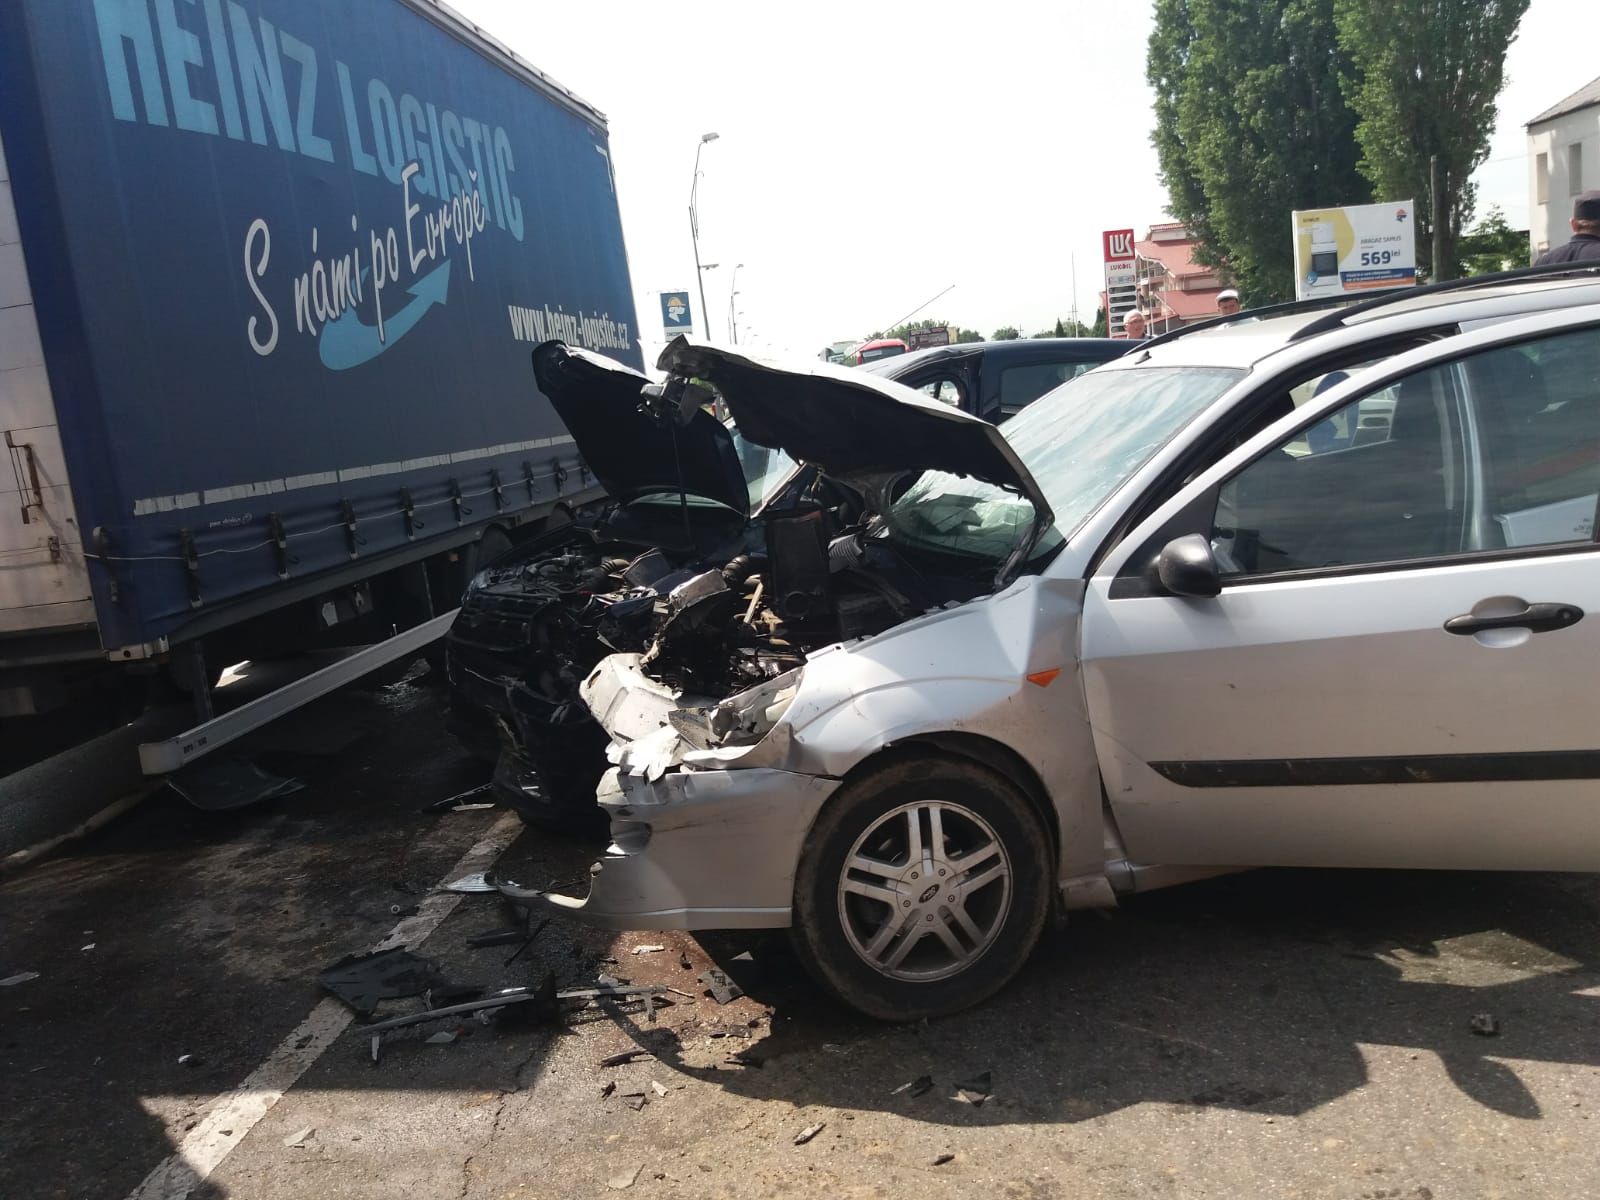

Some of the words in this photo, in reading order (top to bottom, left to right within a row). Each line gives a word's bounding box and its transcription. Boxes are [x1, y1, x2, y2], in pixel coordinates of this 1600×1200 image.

[93, 0, 335, 163] HEINZ
[336, 60, 525, 242] LOGISTIC
[245, 218, 279, 356] S
[295, 214, 363, 337] námi
[371, 227, 399, 342] po
[402, 162, 485, 282] Evropě
[1111, 263, 1132, 271] LUKOIL
[1361, 250, 1391, 266] 569
[1391, 249, 1401, 257] lei
[508, 303, 630, 352] www.heinz-logistic.cz
